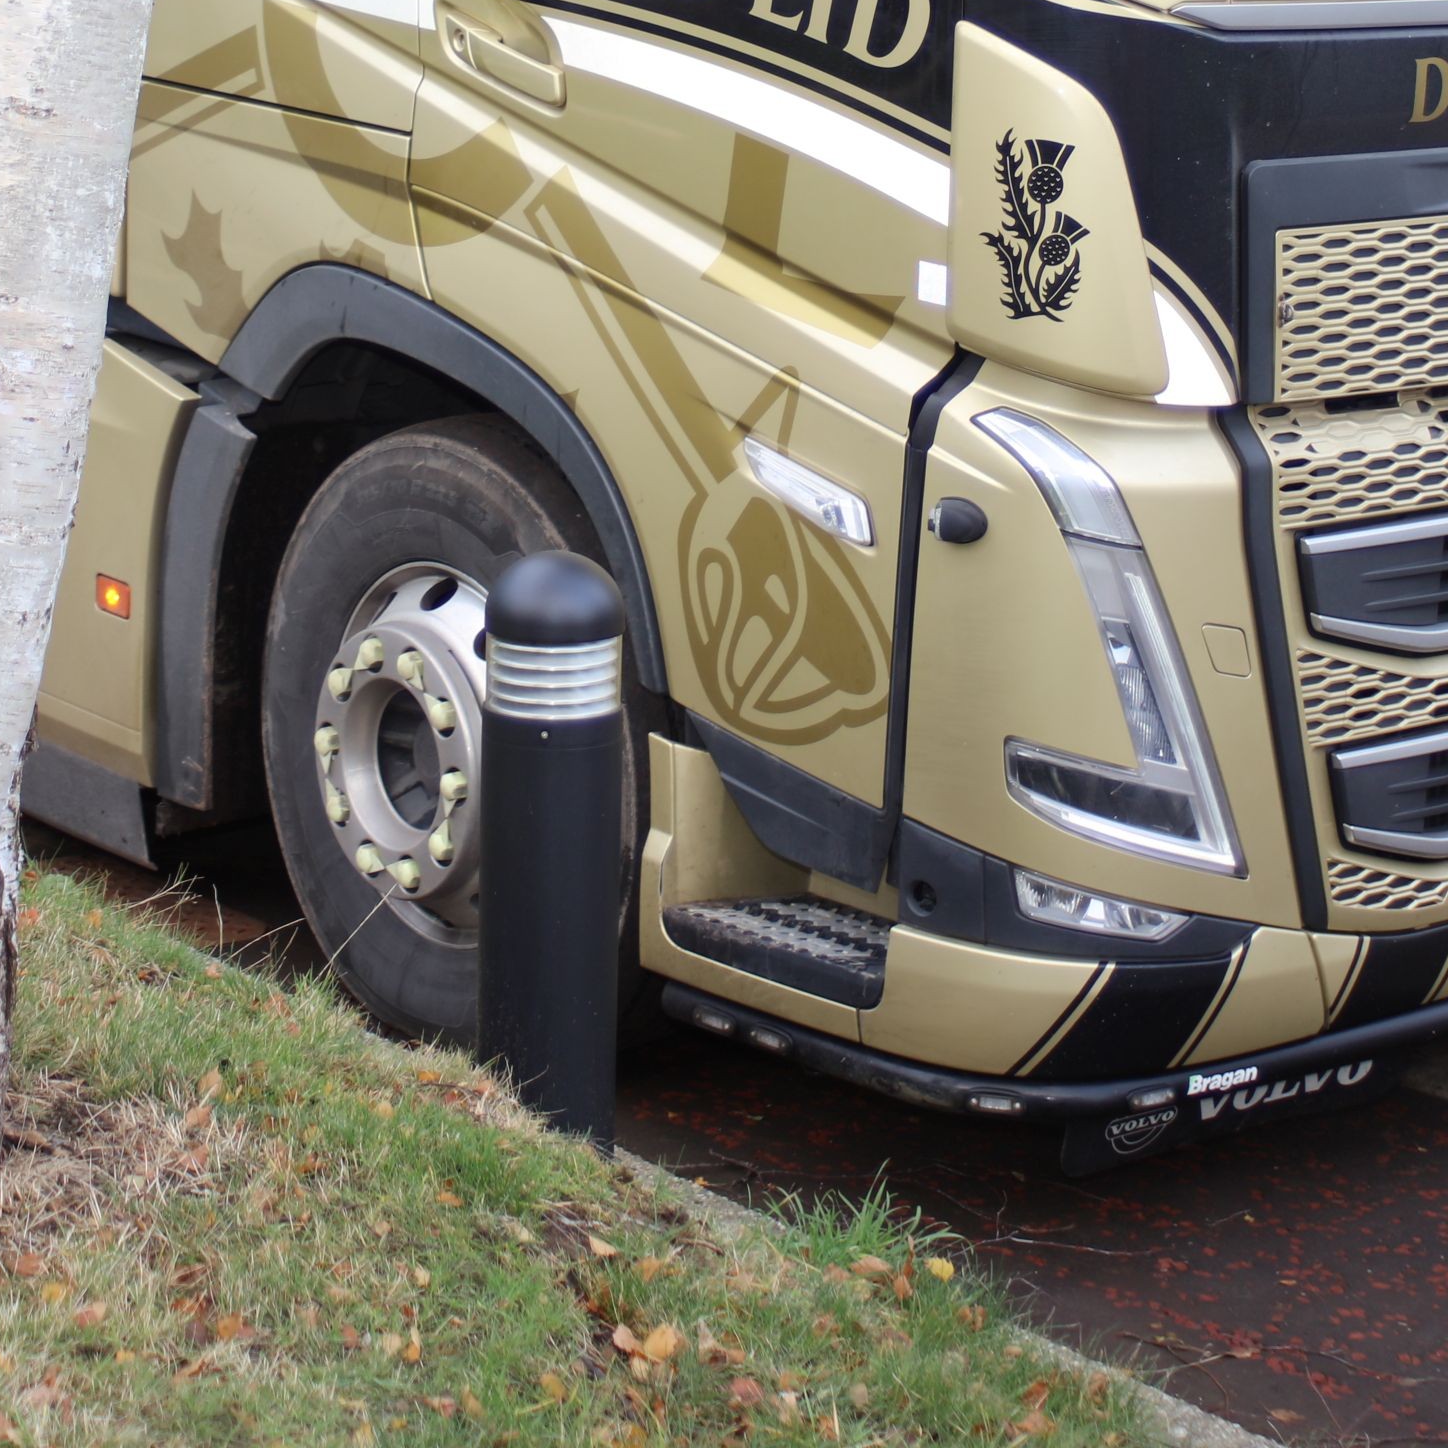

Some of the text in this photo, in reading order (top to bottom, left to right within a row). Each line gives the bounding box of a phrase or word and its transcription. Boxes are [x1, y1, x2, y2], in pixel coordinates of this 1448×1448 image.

[1187, 1065, 1258, 1096] Bragan
[1199, 1059, 1373, 1120] VOLVO
[1109, 1109, 1176, 1136] VOLVO
